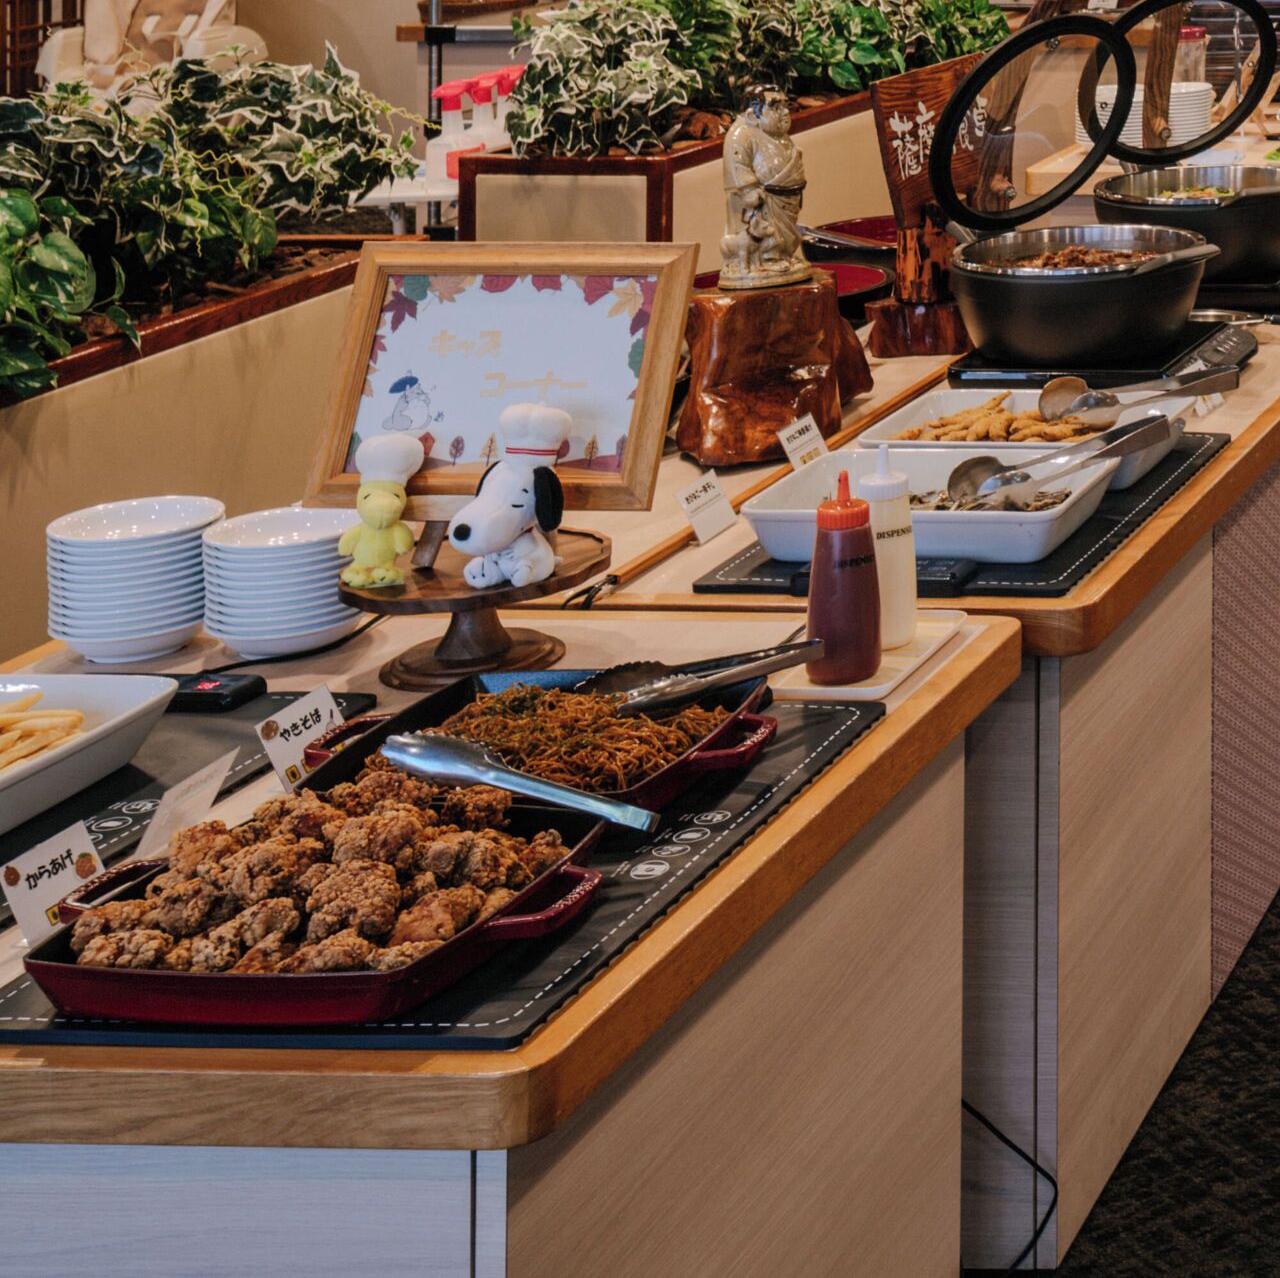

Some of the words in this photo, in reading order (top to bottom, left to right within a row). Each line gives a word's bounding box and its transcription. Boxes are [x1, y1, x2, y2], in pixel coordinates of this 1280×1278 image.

[479, 371, 589, 398] コーナー
[279, 708, 322, 742] やきそば
[25, 848, 74, 890] からあげ
